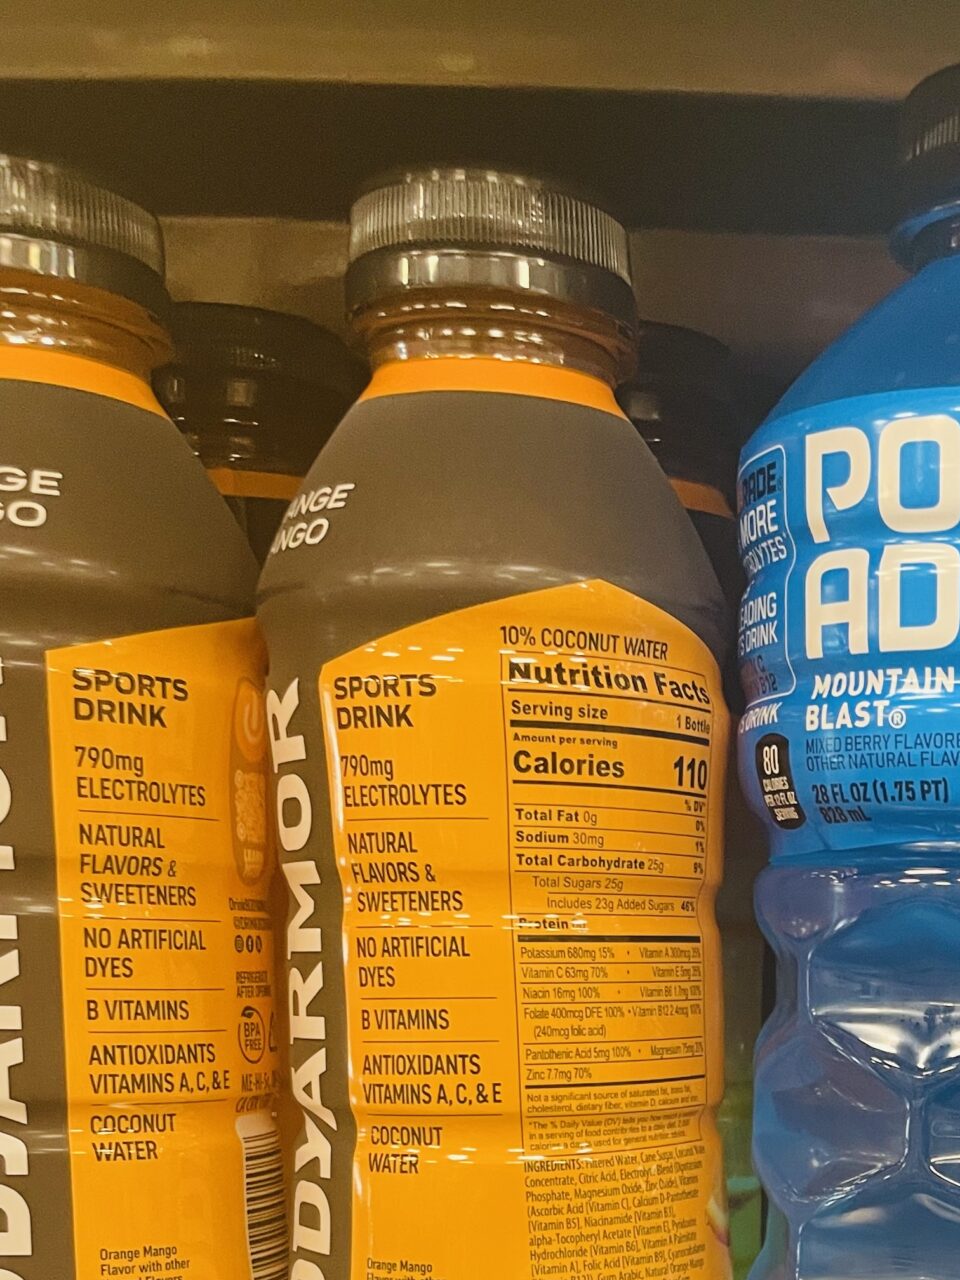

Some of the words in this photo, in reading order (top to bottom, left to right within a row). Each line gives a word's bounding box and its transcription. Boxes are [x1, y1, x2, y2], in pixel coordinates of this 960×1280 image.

[500, 626, 536, 646] 10%
[541, 628, 620, 654] COCONUT
[624, 637, 668, 661] WATER
[72, 668, 189, 701] SPORTS
[334, 674, 437, 700] SPORTS
[509, 660, 648, 694] Nutrition
[654, 671, 711, 705] Facts
[811, 666, 954, 700] MOUNTAIN
[74, 697, 167, 728] DRINK
[336, 704, 414, 730] DRINK
[512, 700, 573, 720] Serving
[578, 704, 609, 720] size
[513, 733, 556, 744] Amount
[559, 735, 576, 746] per
[579, 737, 618, 749] serving
[806, 736, 841, 754] MIXED
[845, 734, 890, 751] BERRY
[75, 746, 144, 777] 790mg
[513, 750, 625, 778] Calories
[673, 756, 708, 789] 110
[763, 745, 778, 774] 80
[807, 754, 846, 771] OTHER
[850, 752, 916, 769] NATURAL
[77, 776, 206, 807] ELECTROLYTES
[344, 783, 467, 807] ELECTROLYTES
[812, 785, 828, 803] 28
[832, 784, 848, 803] FL
[851, 782, 868, 803] OZ
[873, 780, 916, 803] (1.75
[921, 777, 948, 803] PT)
[515, 808, 552, 822] Total
[557, 810, 579, 823] Fat
[583, 811, 598, 825] 0g
[820, 807, 849, 824] 828
[851, 806, 871, 822] mL
[348, 831, 418, 853] NATURAL
[516, 830, 569, 844] Sodium
[573, 833, 605, 848] 30mg
[352, 861, 420, 883] FLAVORS
[425, 863, 436, 882] &
[516, 853, 553, 866] Total
[557, 855, 645, 871] Carbohydrate
[647, 859, 664, 873] 25g
[357, 890, 463, 912] SWEETENERS
[356, 937, 377, 958] NO
[382, 936, 470, 957] ARTIFICIAL
[359, 966, 396, 987] DYES
[243, 1022, 261, 1038] BPA
[361, 1009, 370, 1030] B
[374, 1009, 449, 1030] VITAMINS
[88, 1044, 216, 1066] ANTIOXIDANTS
[362, 1054, 481, 1075] ANTIOXIDANTS
[90, 1113, 176, 1135] COCONUT
[92, 1140, 158, 1162] WATER
[100, 1248, 140, 1263] Orange
[143, 1245, 177, 1260] Mango
[101, 1262, 136, 1276] Flavor
[138, 1260, 162, 1273] with
[165, 1258, 190, 1271] other
